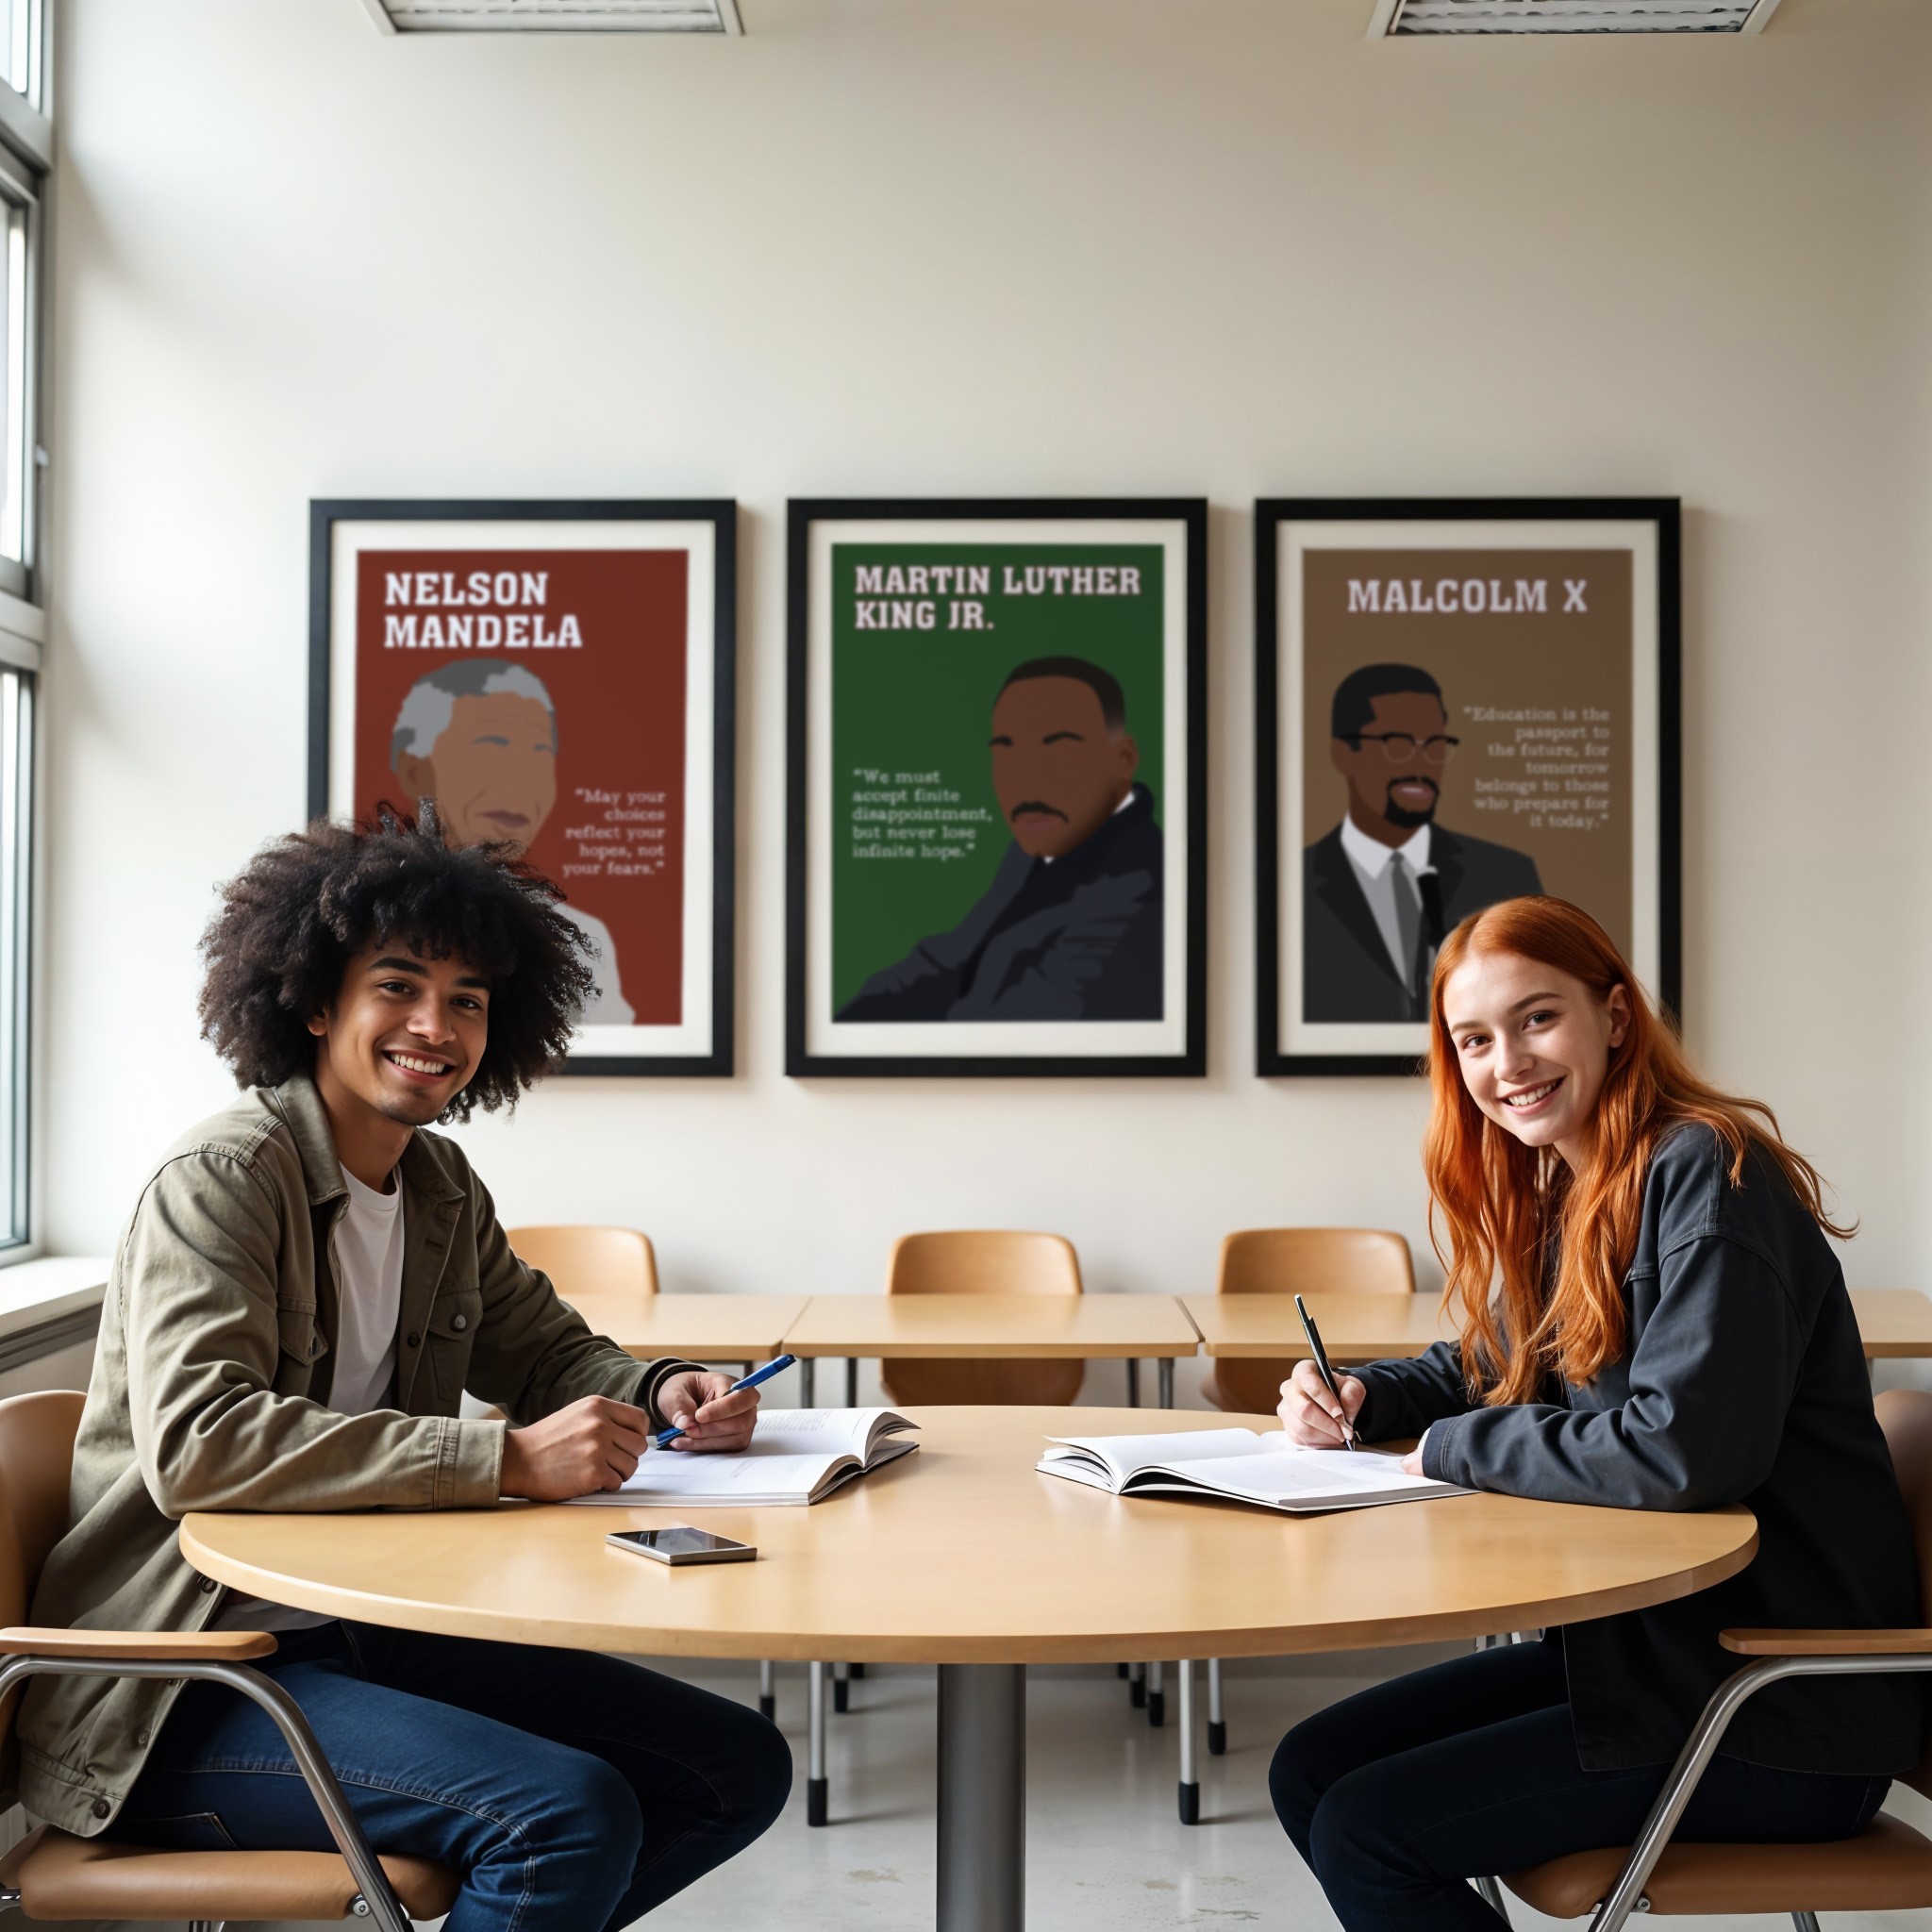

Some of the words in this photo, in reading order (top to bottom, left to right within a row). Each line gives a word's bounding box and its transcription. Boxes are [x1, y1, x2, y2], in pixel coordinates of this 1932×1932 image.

[855, 565, 991, 595] MARTIN
[1003, 565, 1141, 595] LUTHER
[385, 572, 548, 607] NELSON
[1347, 578, 1547, 613] MALCOLM
[1563, 579, 1588, 612] X
[855, 600, 936, 630] KING
[947, 600, 994, 630] JR.
[384, 614, 583, 648] MANDELA
[1563, 709, 1576, 721] is
[1582, 708, 1609, 721] the
[1515, 726, 1586, 742] passport
[1593, 726, 1609, 738] to
[1488, 742, 1515, 757] the
[1521, 742, 1578, 758] future,
[1585, 742, 1609, 757] for
[1525, 762, 1608, 774] tomorrow
[895, 771, 940, 783] must
[1475, 778, 1537, 795] belongs
[1542, 779, 1559, 791] to
[1565, 779, 1609, 791] those
[627, 792, 666, 806] your
[853, 790, 908, 806] accept
[914, 788, 959, 802] finite
[1474, 796, 1508, 809] who
[1513, 795, 1579, 813] prepare
[1585, 796, 1609, 809] for
[604, 807, 665, 821] choices
[852, 807, 992, 824] disappointment,
[1530, 815, 1542, 827] it
[565, 824, 620, 839] reflect
[627, 828, 665, 841] your
[853, 825, 880, 840] but
[887, 828, 936, 840] never
[942, 825, 975, 839] lose
[579, 843, 632, 860] hopes,
[638, 844, 664, 857] not
[853, 843, 915, 858] infinite
[562, 860, 602, 877] your
